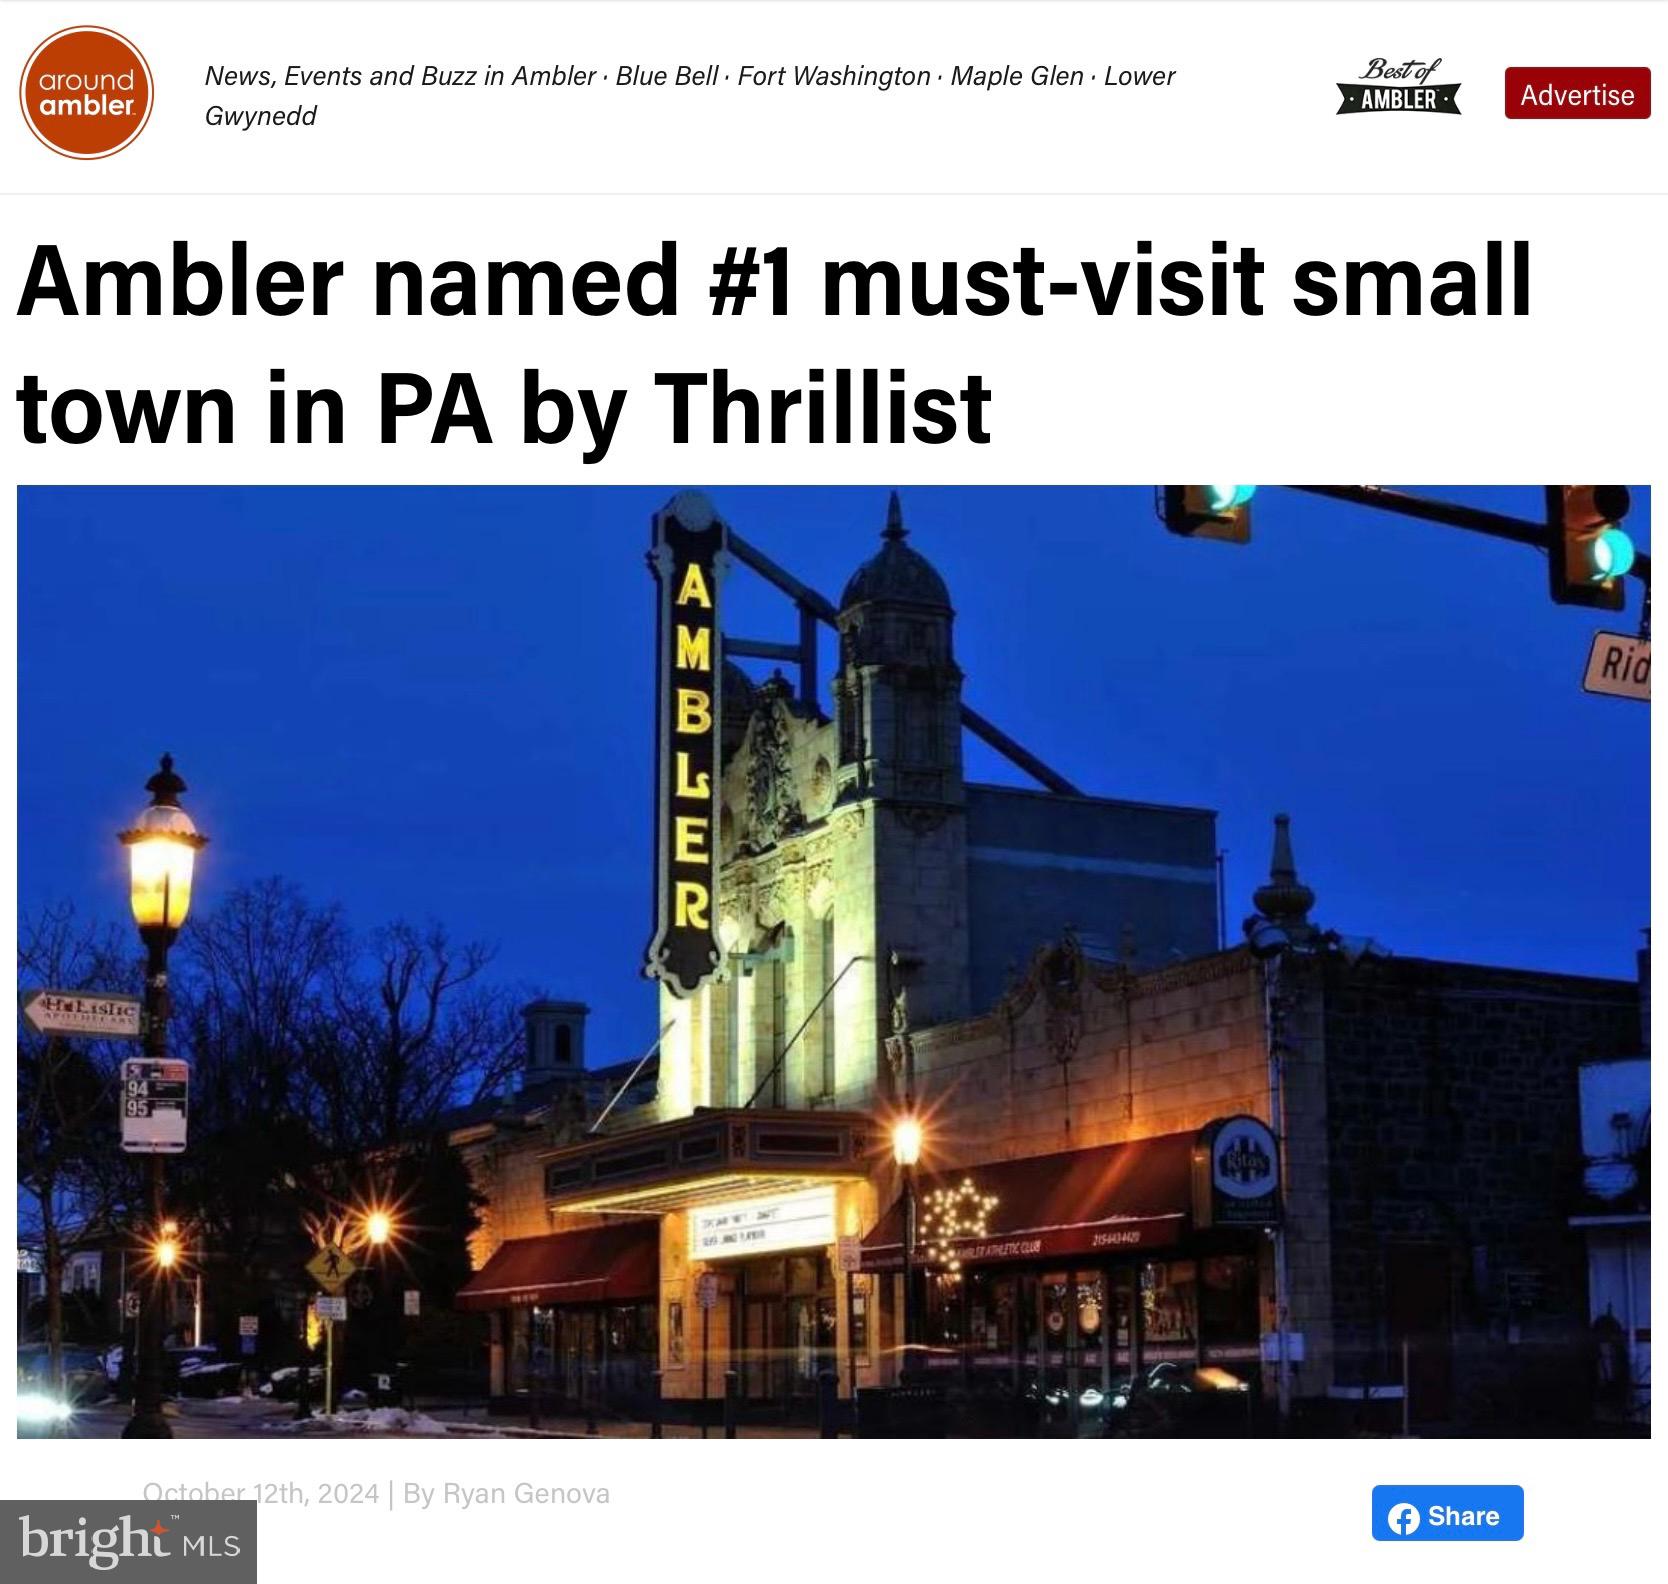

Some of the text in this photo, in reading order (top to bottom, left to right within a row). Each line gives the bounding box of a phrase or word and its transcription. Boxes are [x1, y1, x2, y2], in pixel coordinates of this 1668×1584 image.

[40, 69, 134, 90] around
[205, 65, 1176, 92] News, Events and Buzz in Ambler Blue Bell Fort Washington Maple Glen Lower
[1358, 57, 1442, 85] Best of
[40, 94, 134, 115] ambler
[1361, 88, 1437, 109] AMBLER
[1521, 83, 1635, 107] Advertise
[205, 104, 318, 131] Gwynedd
[16, 241, 1529, 316] Ambler named #1 must-visit small
[16, 368, 991, 464] town in PA by Thrillist
[674, 563, 712, 930] AMBLER
[128, 1080, 148, 1098] 94
[127, 1100, 148, 1117] 95
[143, 1481, 610, 1510] October 12th, 2024 By Ryan Genova
[1428, 1505, 1500, 1528] Share
